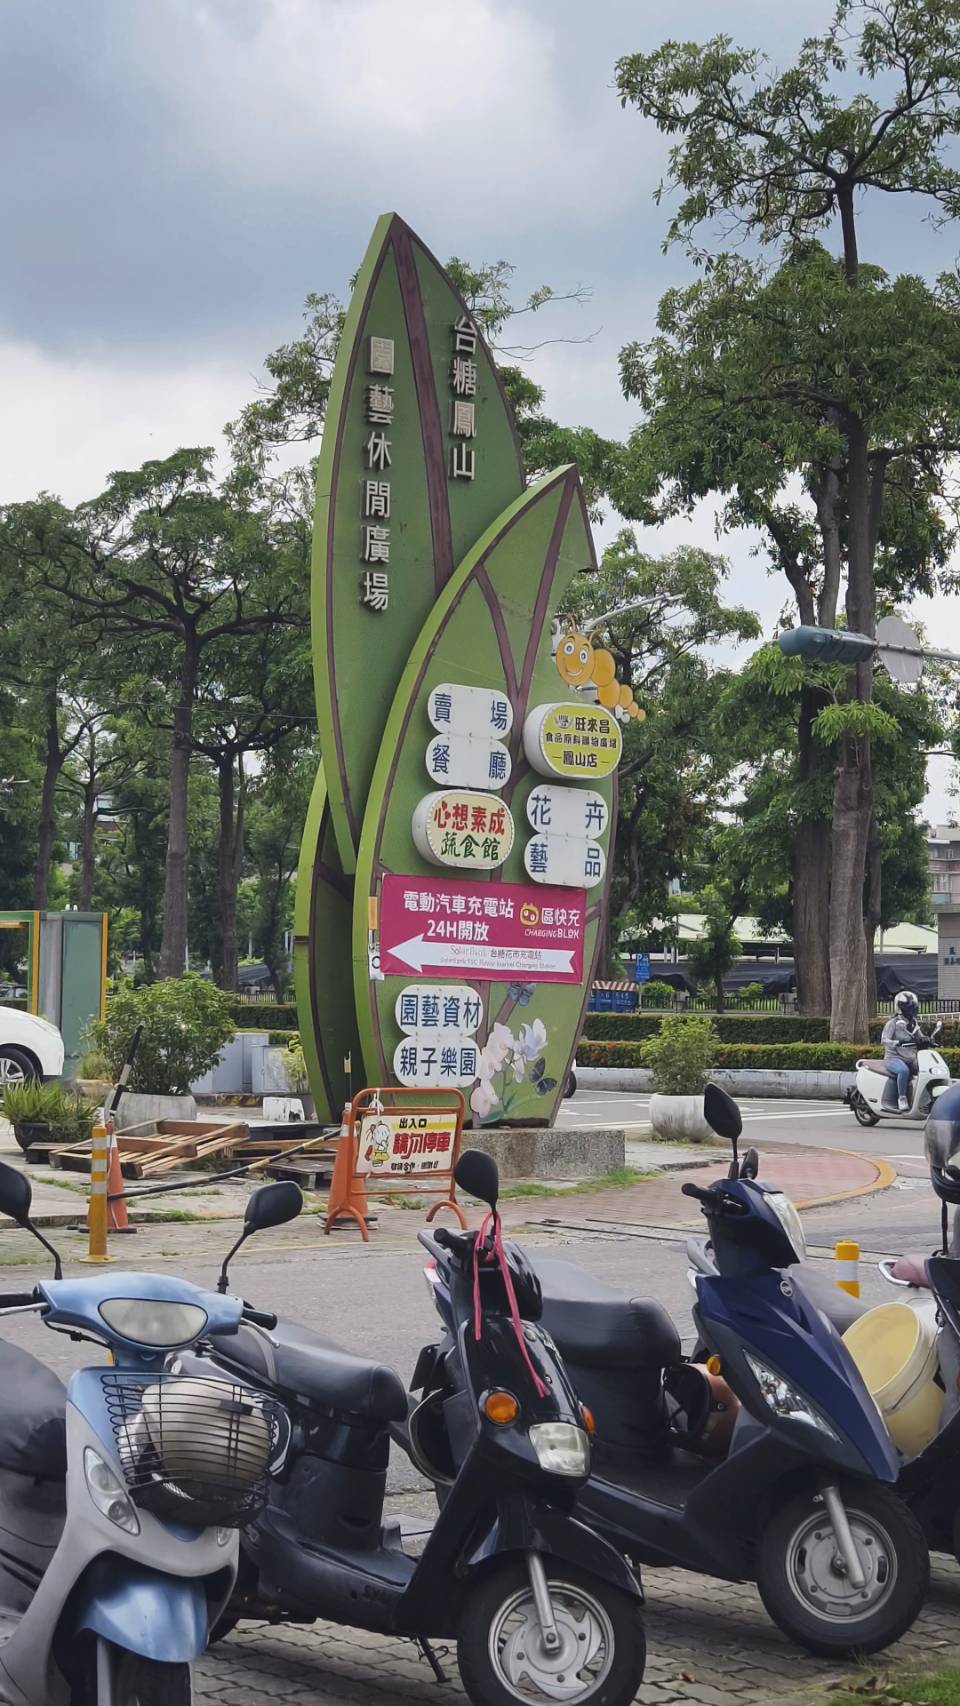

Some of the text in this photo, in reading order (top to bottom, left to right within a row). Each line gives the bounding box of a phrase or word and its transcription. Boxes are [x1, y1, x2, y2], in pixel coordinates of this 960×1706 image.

[453, 315, 478, 481] 台糖鳳山
[364, 336, 395, 611] 園藝休閒廣場
[434, 693, 508, 731] 賣場
[575, 717, 610, 734] 旺來昌
[432, 743, 507, 780] 餐廳
[563, 751, 597, 768] 鳳山店
[433, 800, 506, 836] 心想素成
[531, 794, 604, 831] 花卉
[440, 832, 501, 861] 蔬食館
[529, 842, 601, 878] 藝品
[403, 891, 515, 919] 電動汽車充電站
[541, 907, 581, 927] 區快充
[427, 919, 490, 942] 24H開放
[400, 994, 481, 1029] 園藝資材
[400, 1047, 477, 1077] 親子樂園
[399, 1118, 428, 1129] 出入口
[392, 1131, 451, 1160] 請勿停車
